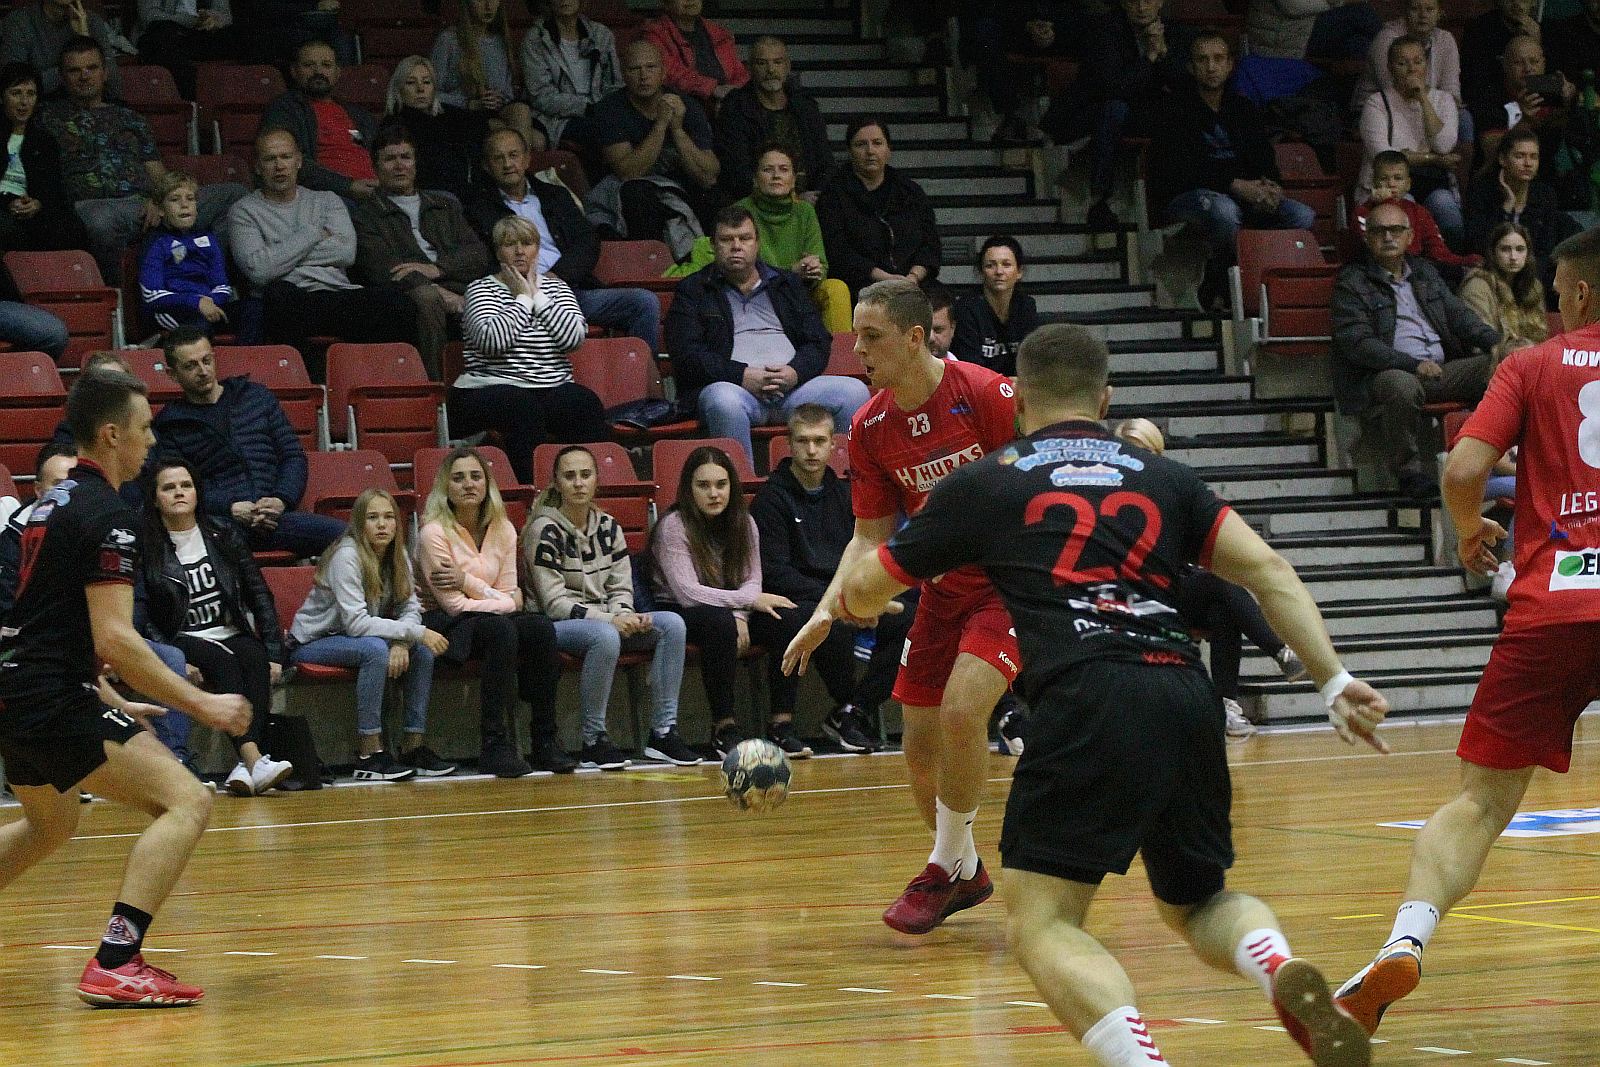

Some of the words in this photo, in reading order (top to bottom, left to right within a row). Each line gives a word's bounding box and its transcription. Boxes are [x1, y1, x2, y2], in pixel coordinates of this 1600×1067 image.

[907, 412, 931, 437] 23
[919, 446, 983, 481] HURAS
[1024, 491, 1171, 588] 22
